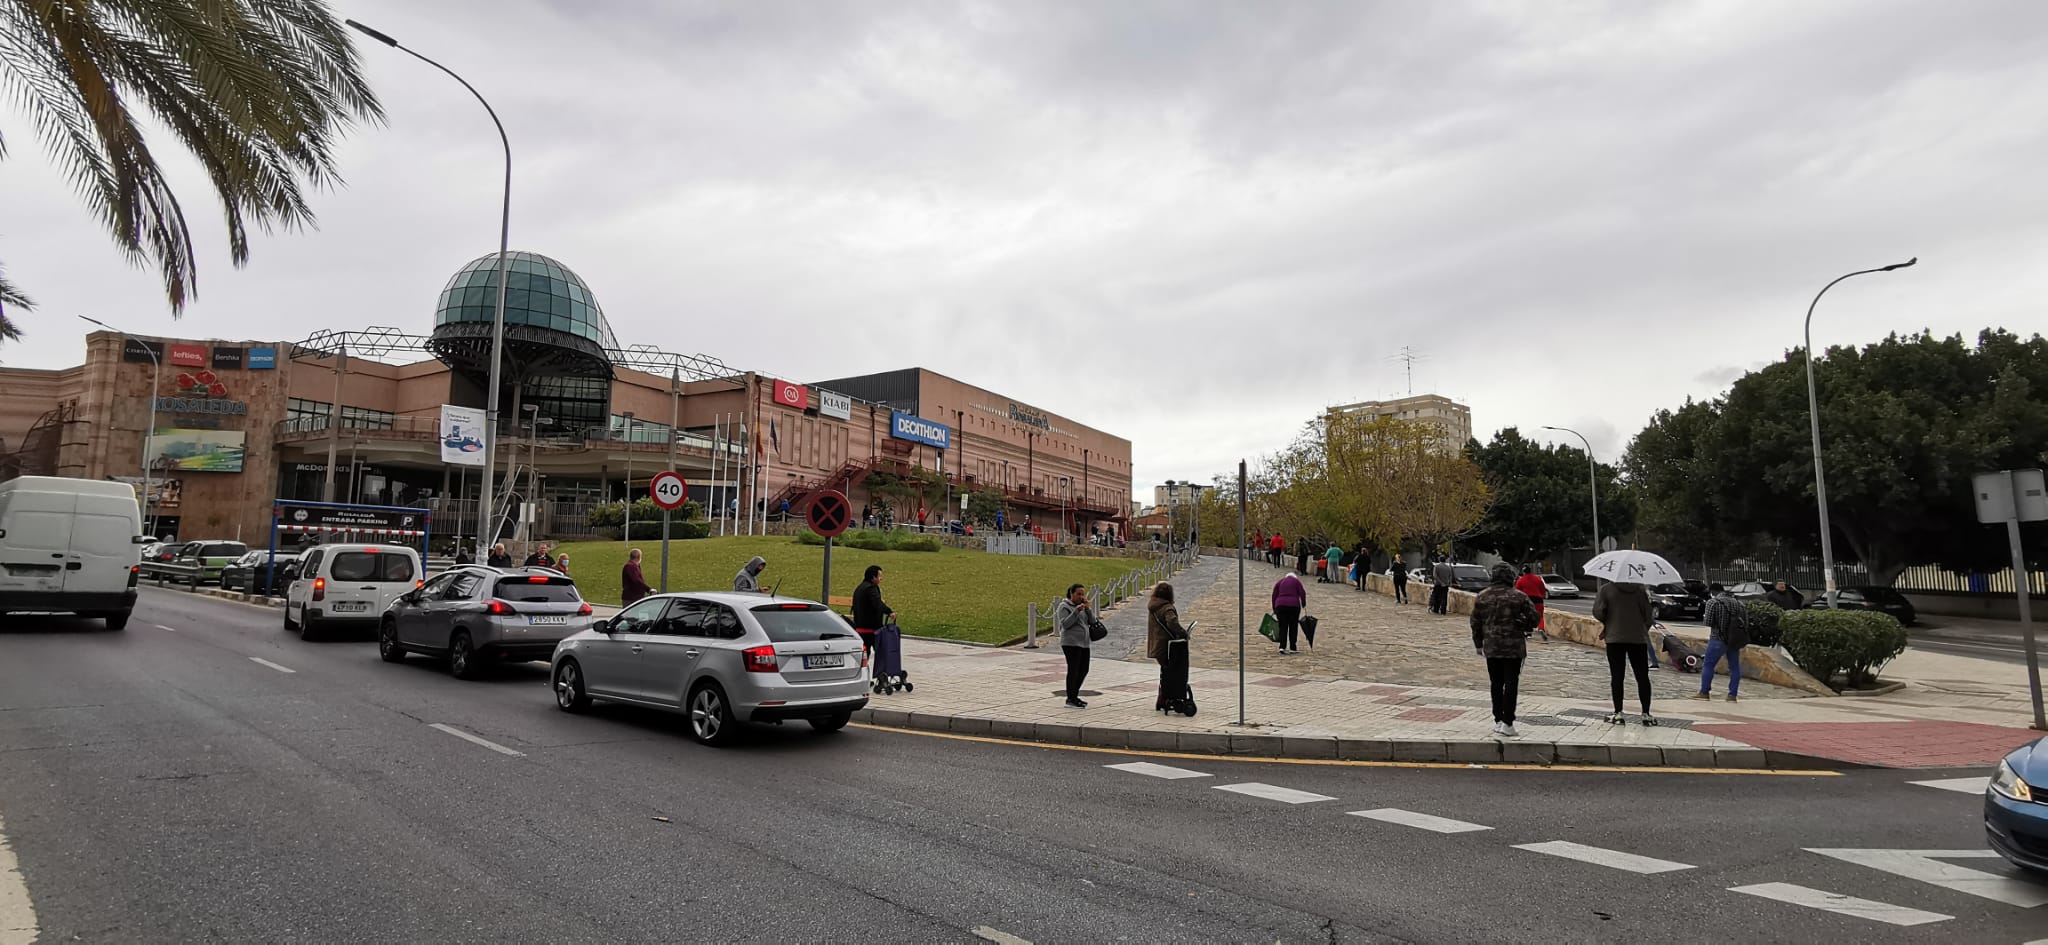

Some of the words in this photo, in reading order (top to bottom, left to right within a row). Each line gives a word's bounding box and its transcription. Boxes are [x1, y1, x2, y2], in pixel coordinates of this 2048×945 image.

[823, 396, 849, 412] KIABI
[898, 417, 946, 443] DECATHLON
[658, 483, 680, 497] 40
[321, 516, 355, 524] ENTRADA
[357, 517, 389, 525] PARKING
